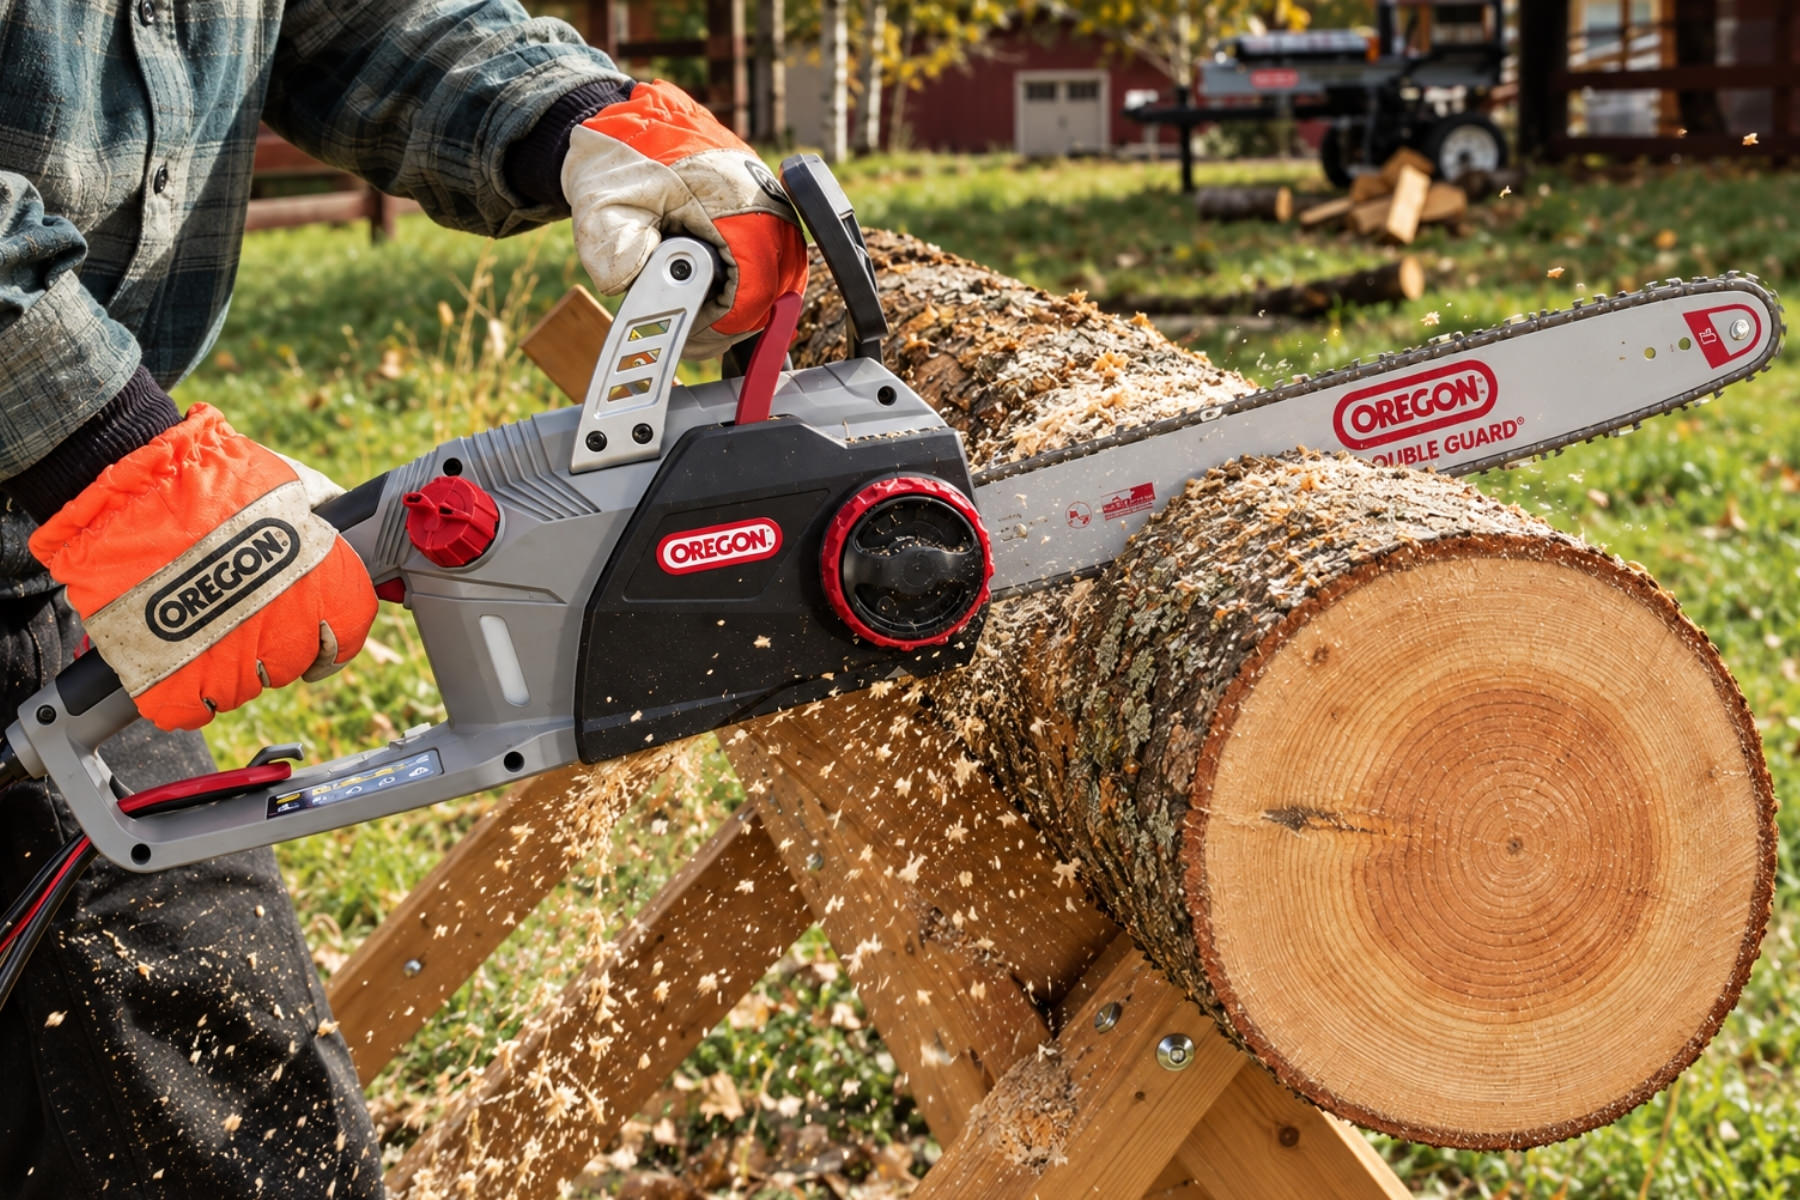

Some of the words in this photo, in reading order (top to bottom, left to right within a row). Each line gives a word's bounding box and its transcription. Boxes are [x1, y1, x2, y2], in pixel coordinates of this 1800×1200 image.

[1352, 375, 1480, 433] OREGON
[1372, 440, 1440, 468] OUBLE
[670, 528, 767, 563] OREGON
[159, 531, 284, 628] OREGON
